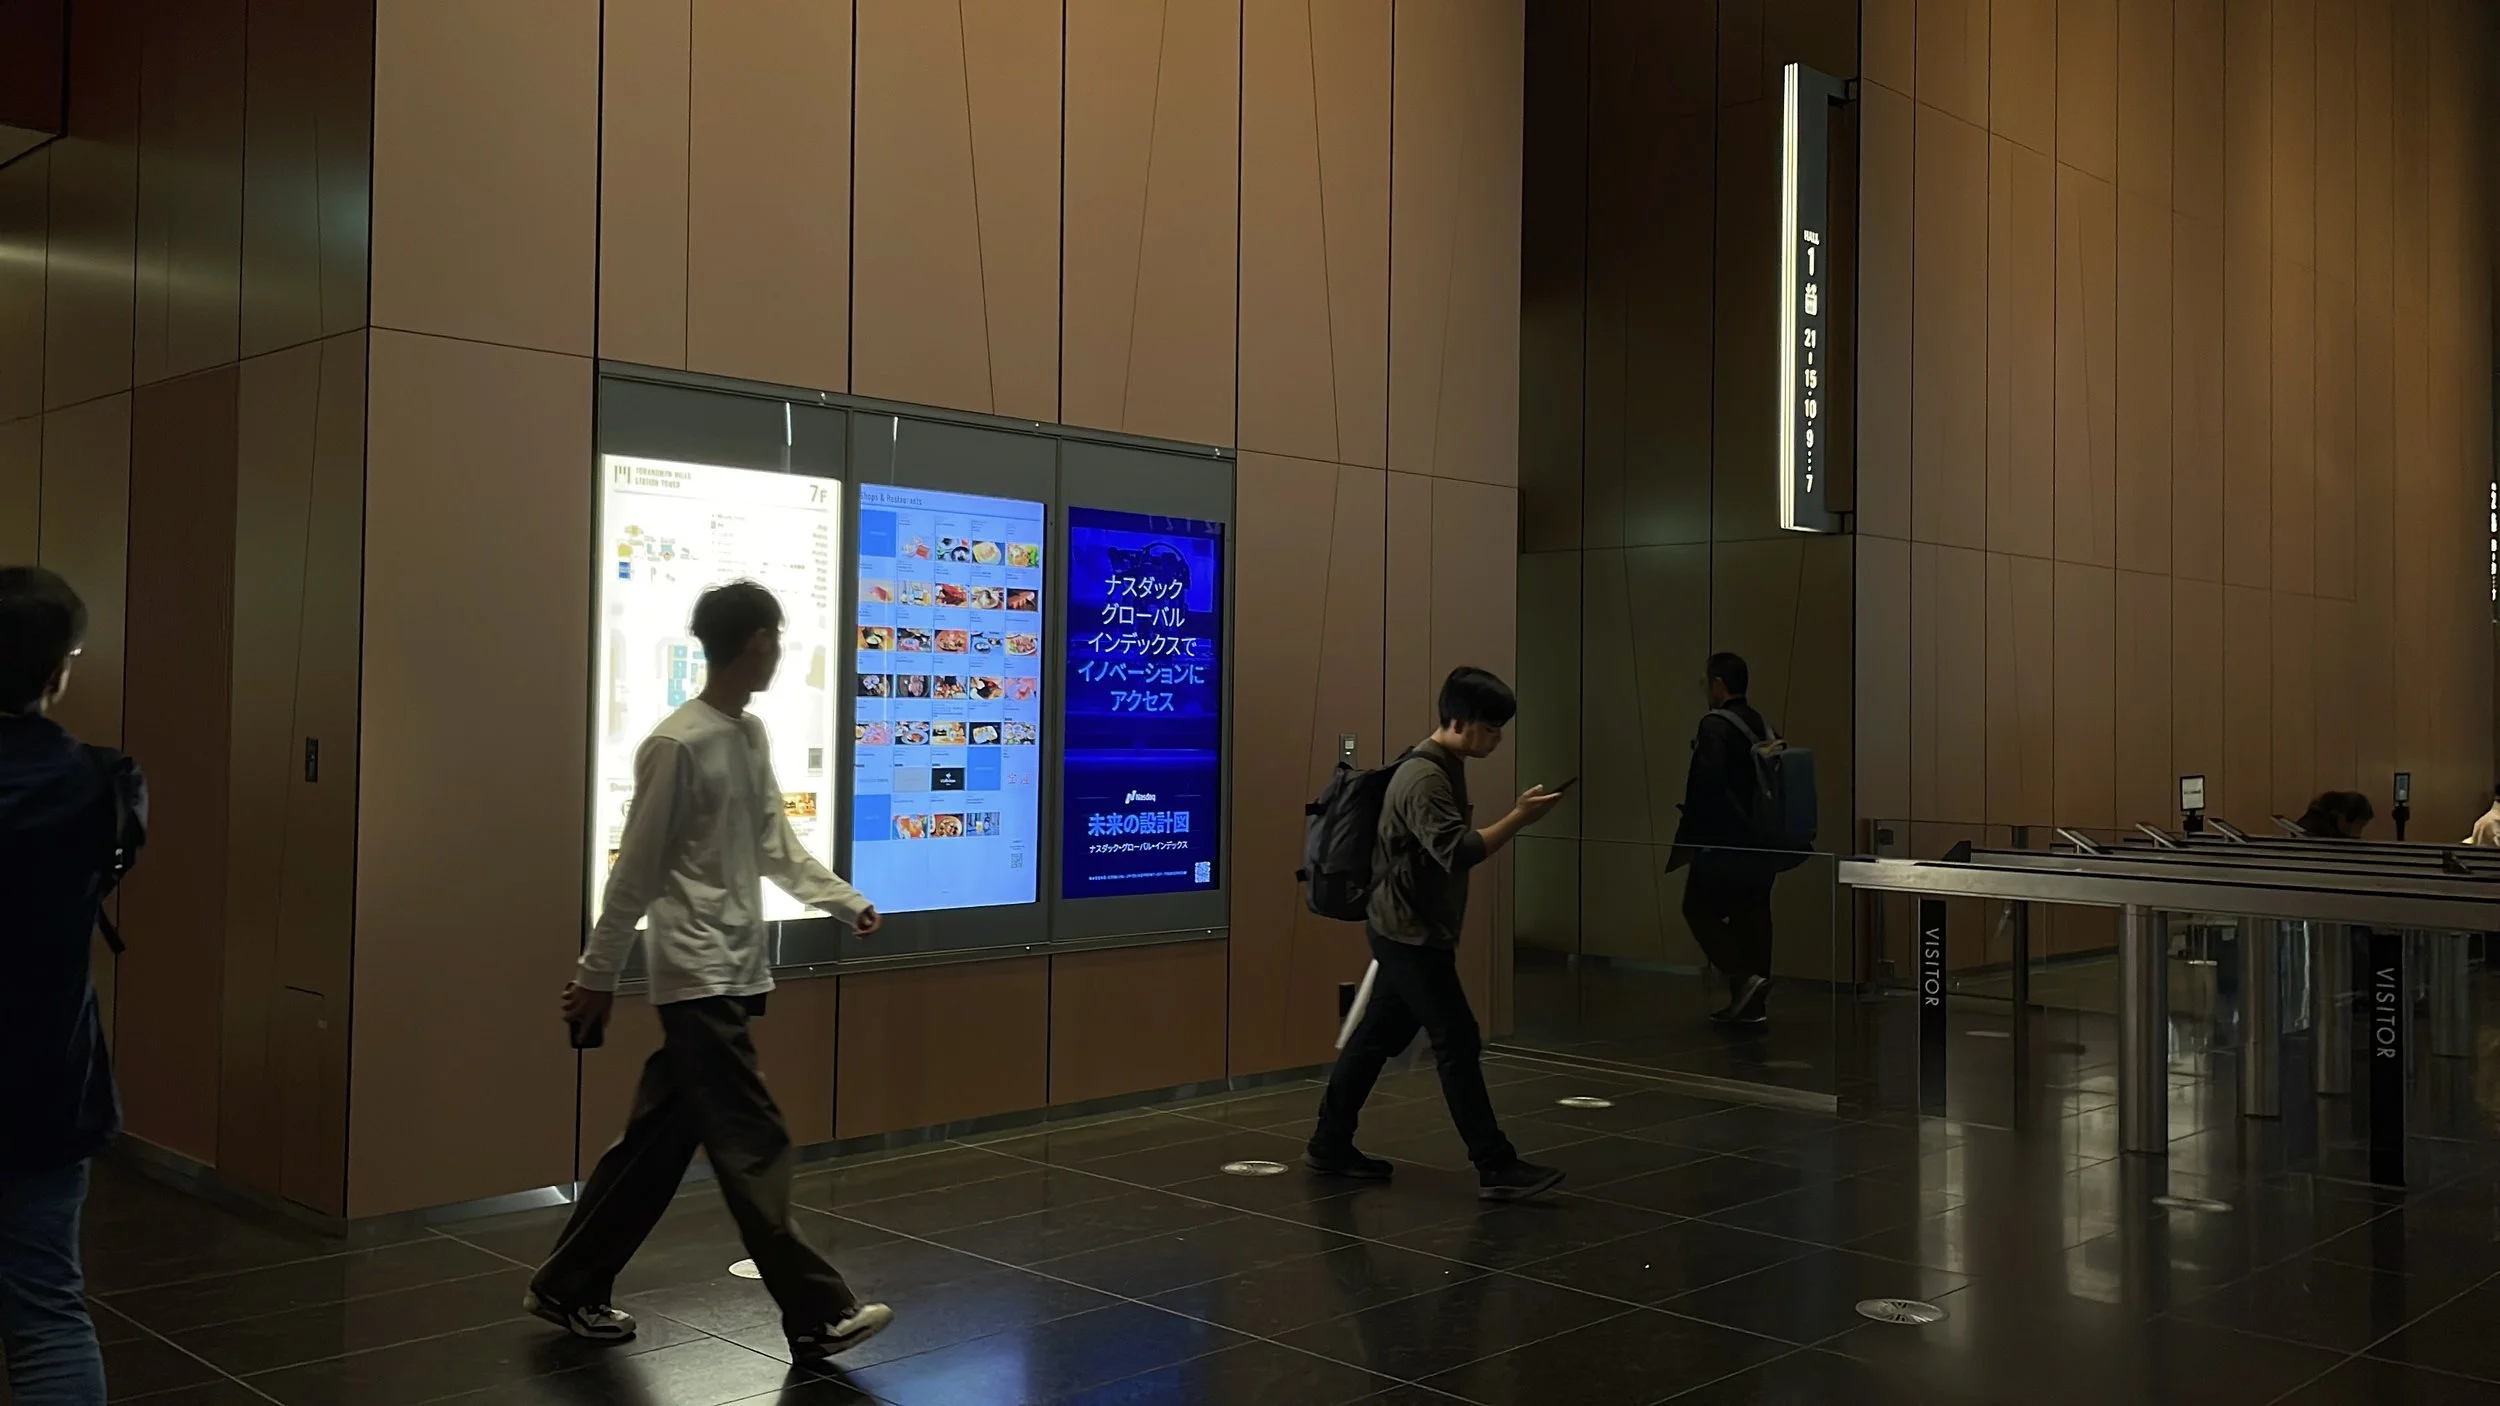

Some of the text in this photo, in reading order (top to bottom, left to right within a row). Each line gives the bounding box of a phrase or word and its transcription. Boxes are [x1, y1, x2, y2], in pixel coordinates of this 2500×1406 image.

[1804, 230, 1820, 245] HALL
[1807, 247, 1815, 276] 1
[1804, 328, 1816, 348] 21
[1804, 369, 1817, 389] 15
[1804, 399, 1817, 419] 10
[1806, 429, 1814, 448] 9
[809, 484, 828, 503] 7F
[1805, 474, 1814, 493] 7
[1105, 575, 1183, 599] ナスダック
[1101, 603, 1185, 627] グローバル
[1088, 632, 1197, 656] インデックスで
[1078, 660, 1205, 685] イノベーションに
[1110, 689, 1174, 711] アクセス
[1088, 811, 1190, 836] 未来の設計図
[1924, 927, 1940, 1006] VISITOR
[2375, 967, 2396, 1058] VISITOR
